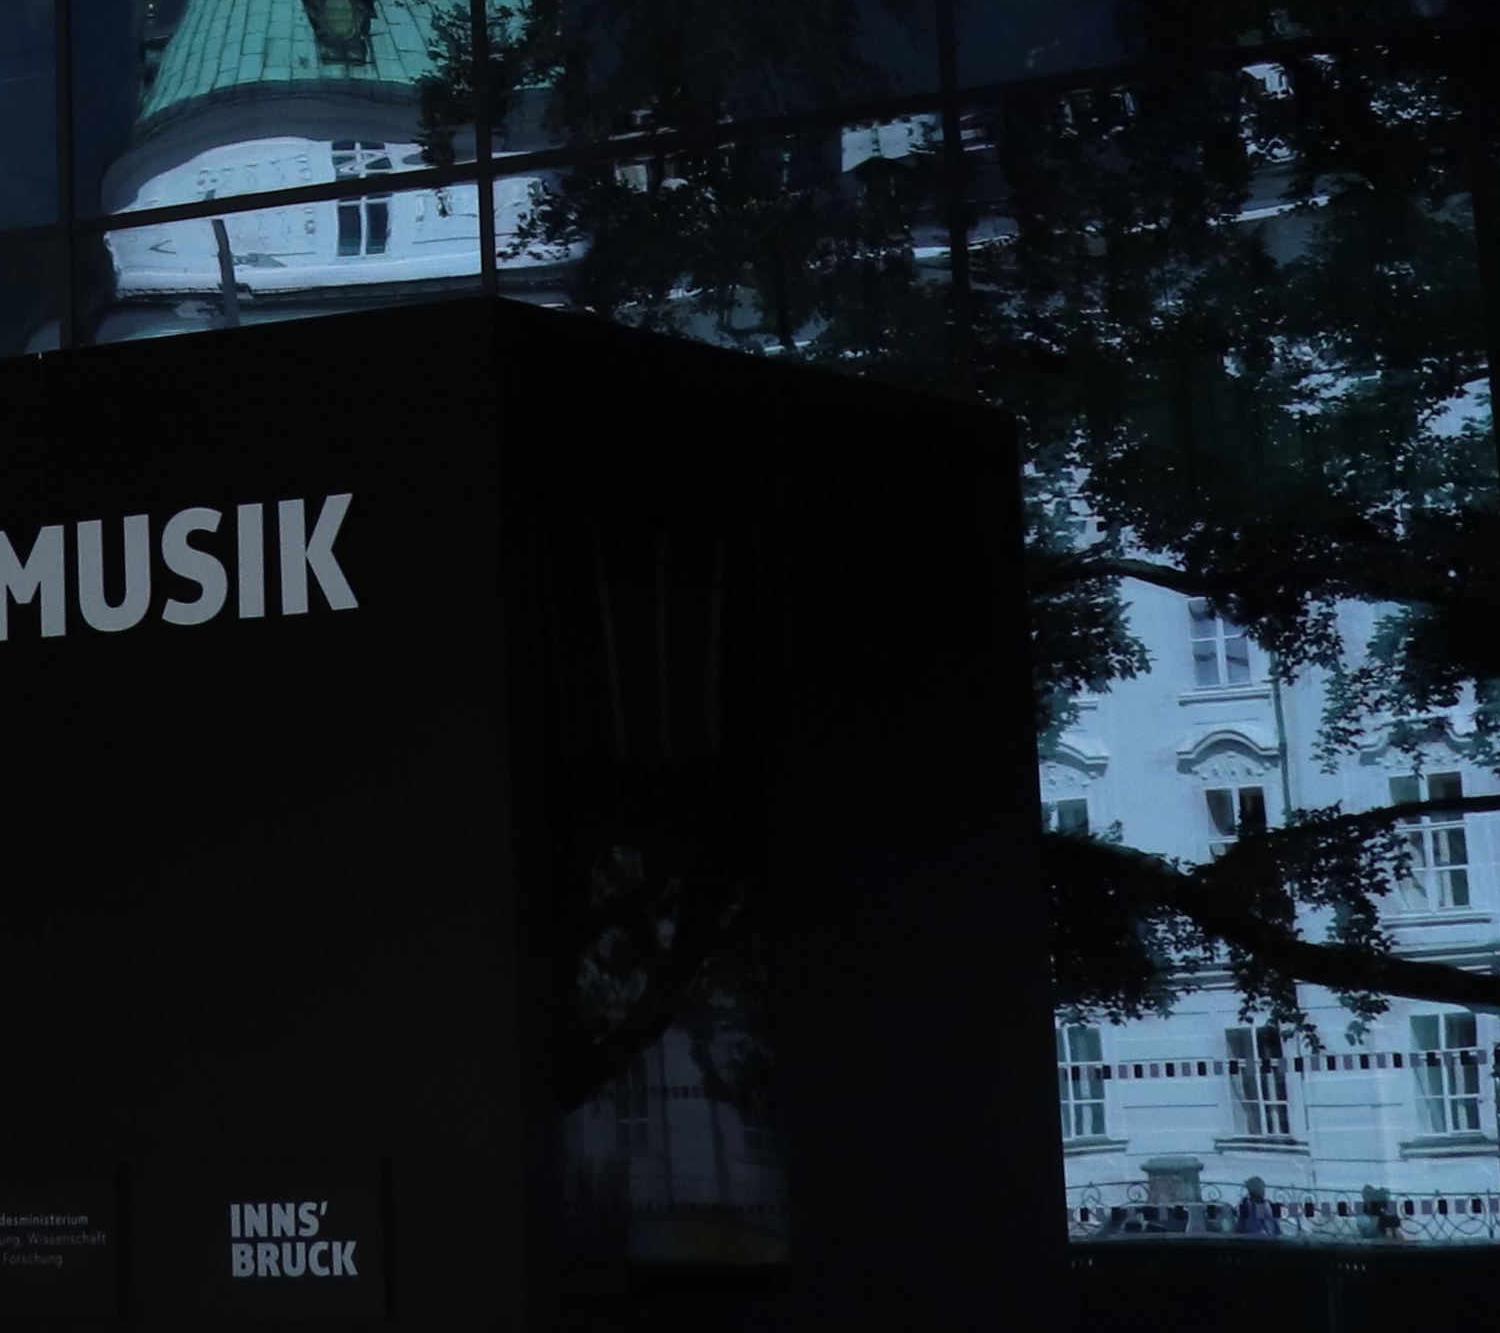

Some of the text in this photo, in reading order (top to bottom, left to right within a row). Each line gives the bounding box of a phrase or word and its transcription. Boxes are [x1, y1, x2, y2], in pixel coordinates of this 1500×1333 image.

[27, 1230, 107, 1246] Wissenschaft
[3, 1251, 63, 1268] Forschung
[231, 1240, 359, 1278] BRUCK
